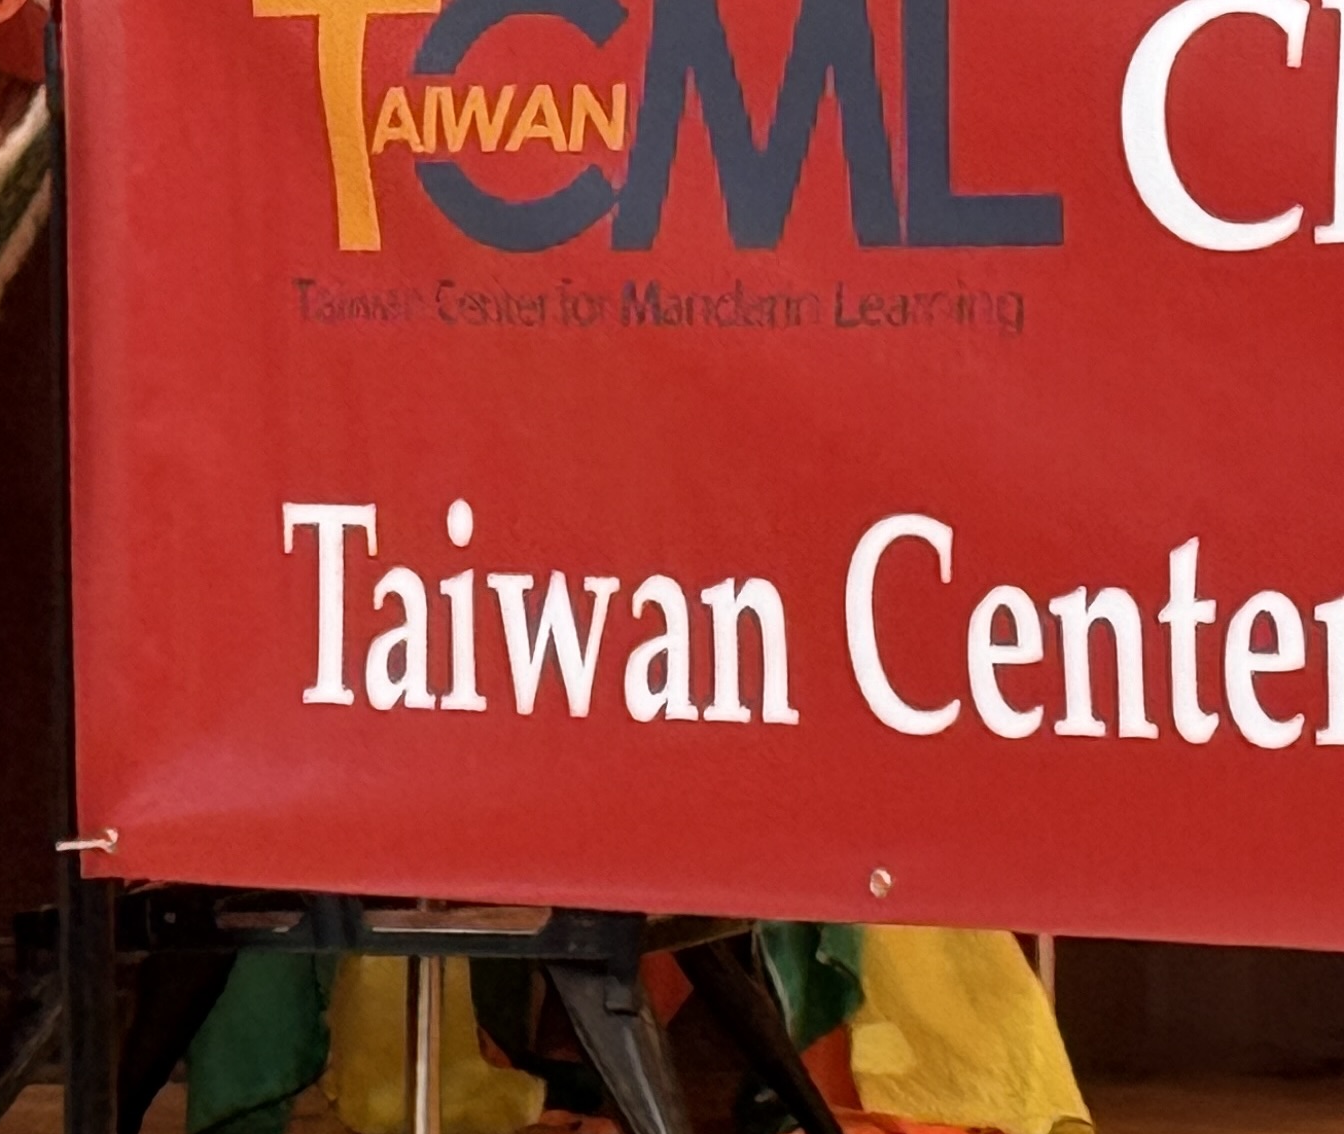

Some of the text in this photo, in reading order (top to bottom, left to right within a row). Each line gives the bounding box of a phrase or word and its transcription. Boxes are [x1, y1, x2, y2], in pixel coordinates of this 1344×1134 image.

[1121, 0, 1344, 252] C
[436, 278, 547, 328] Center
[620, 278, 820, 330] Mandarin
[834, 280, 1026, 337] Learning
[282, 499, 800, 726] Taiwan
